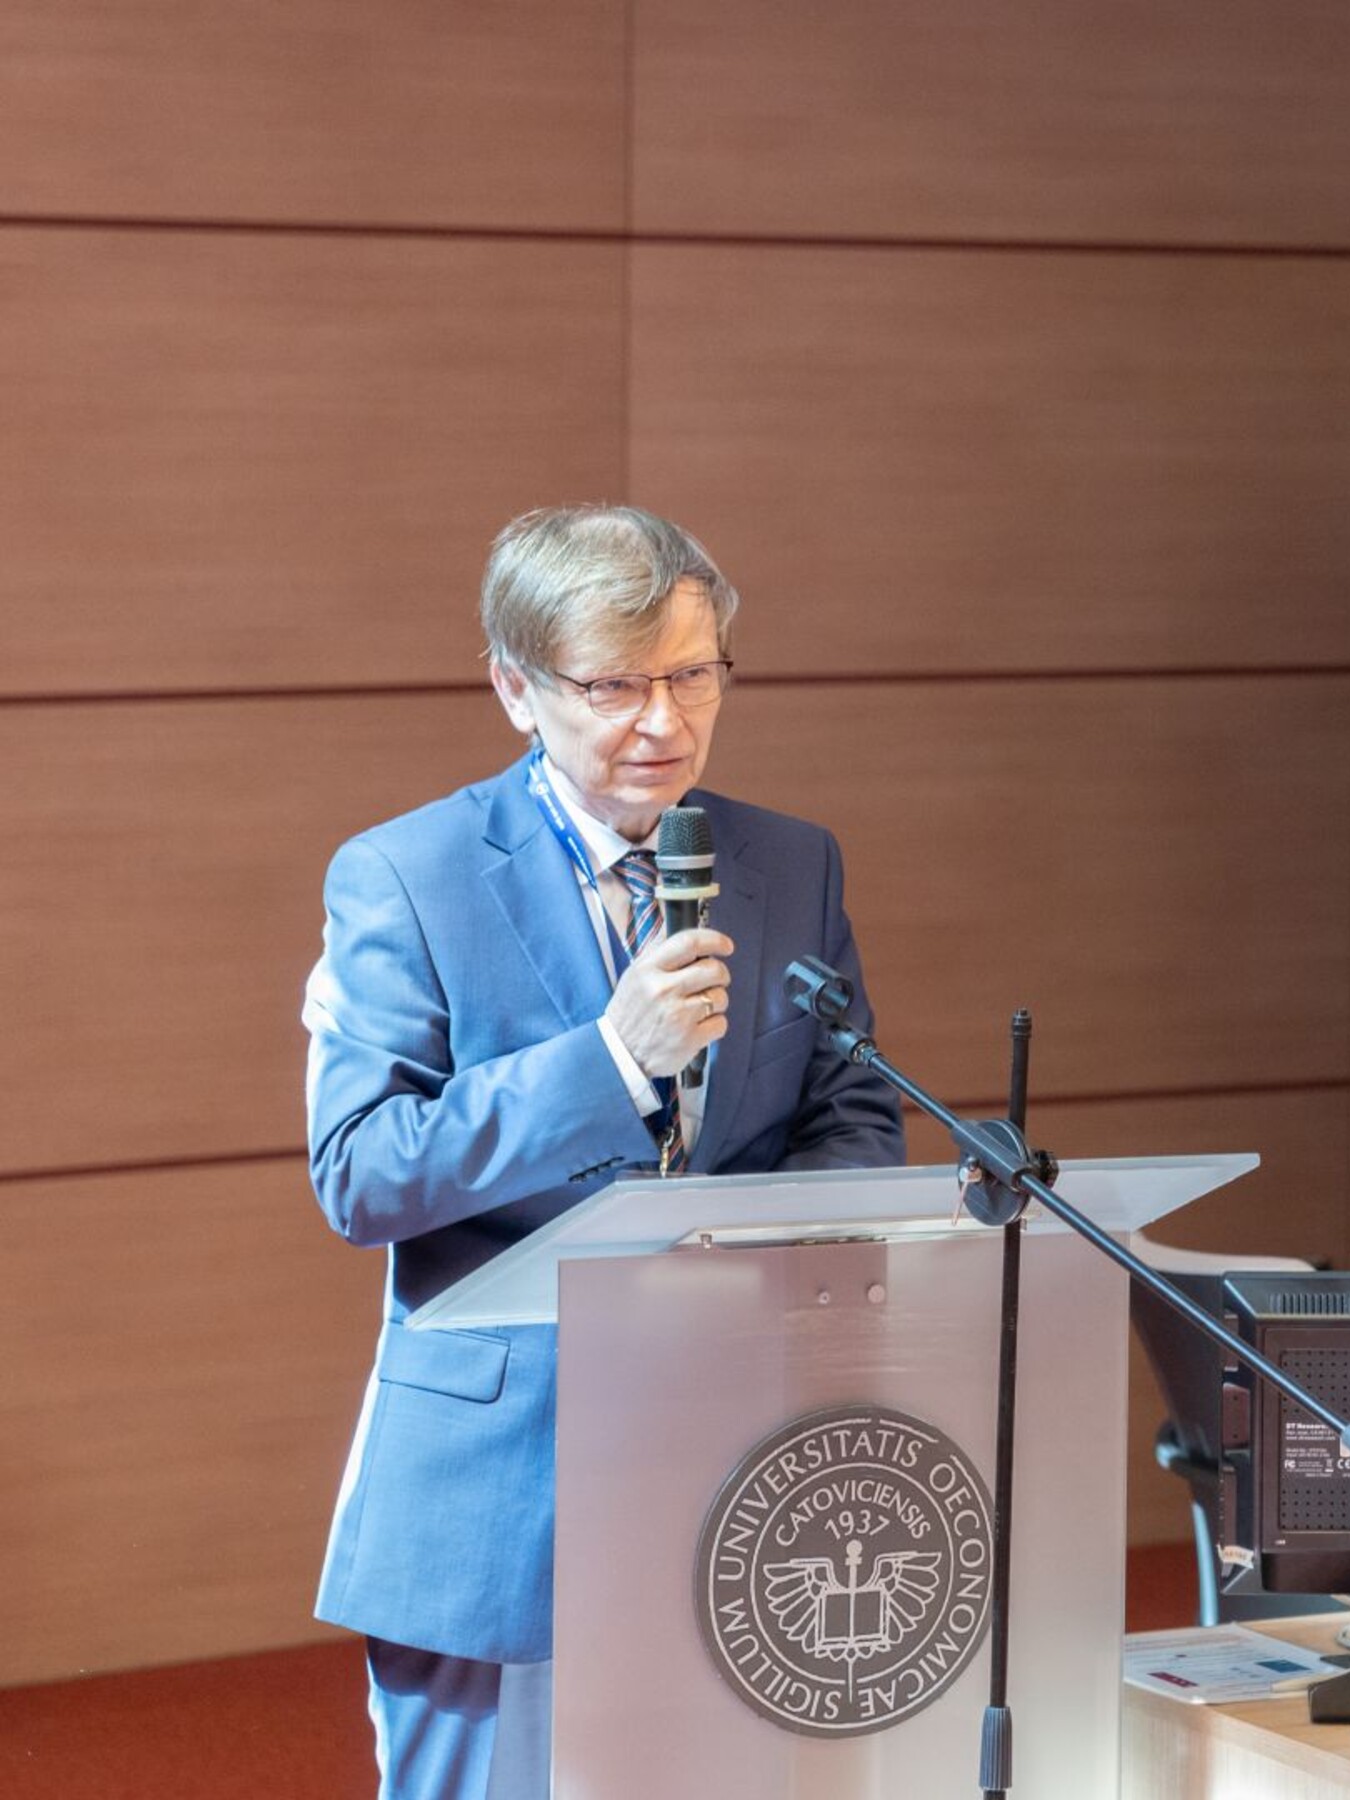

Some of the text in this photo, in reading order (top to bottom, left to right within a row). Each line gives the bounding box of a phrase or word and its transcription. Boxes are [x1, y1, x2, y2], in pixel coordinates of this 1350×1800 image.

[774, 1478, 931, 1547] CATOVICIENSIS
[823, 1508, 890, 1541] 1937
[717, 1428, 986, 1720] SIGILLUM UNIVERSITATIS OECONOMICAE
